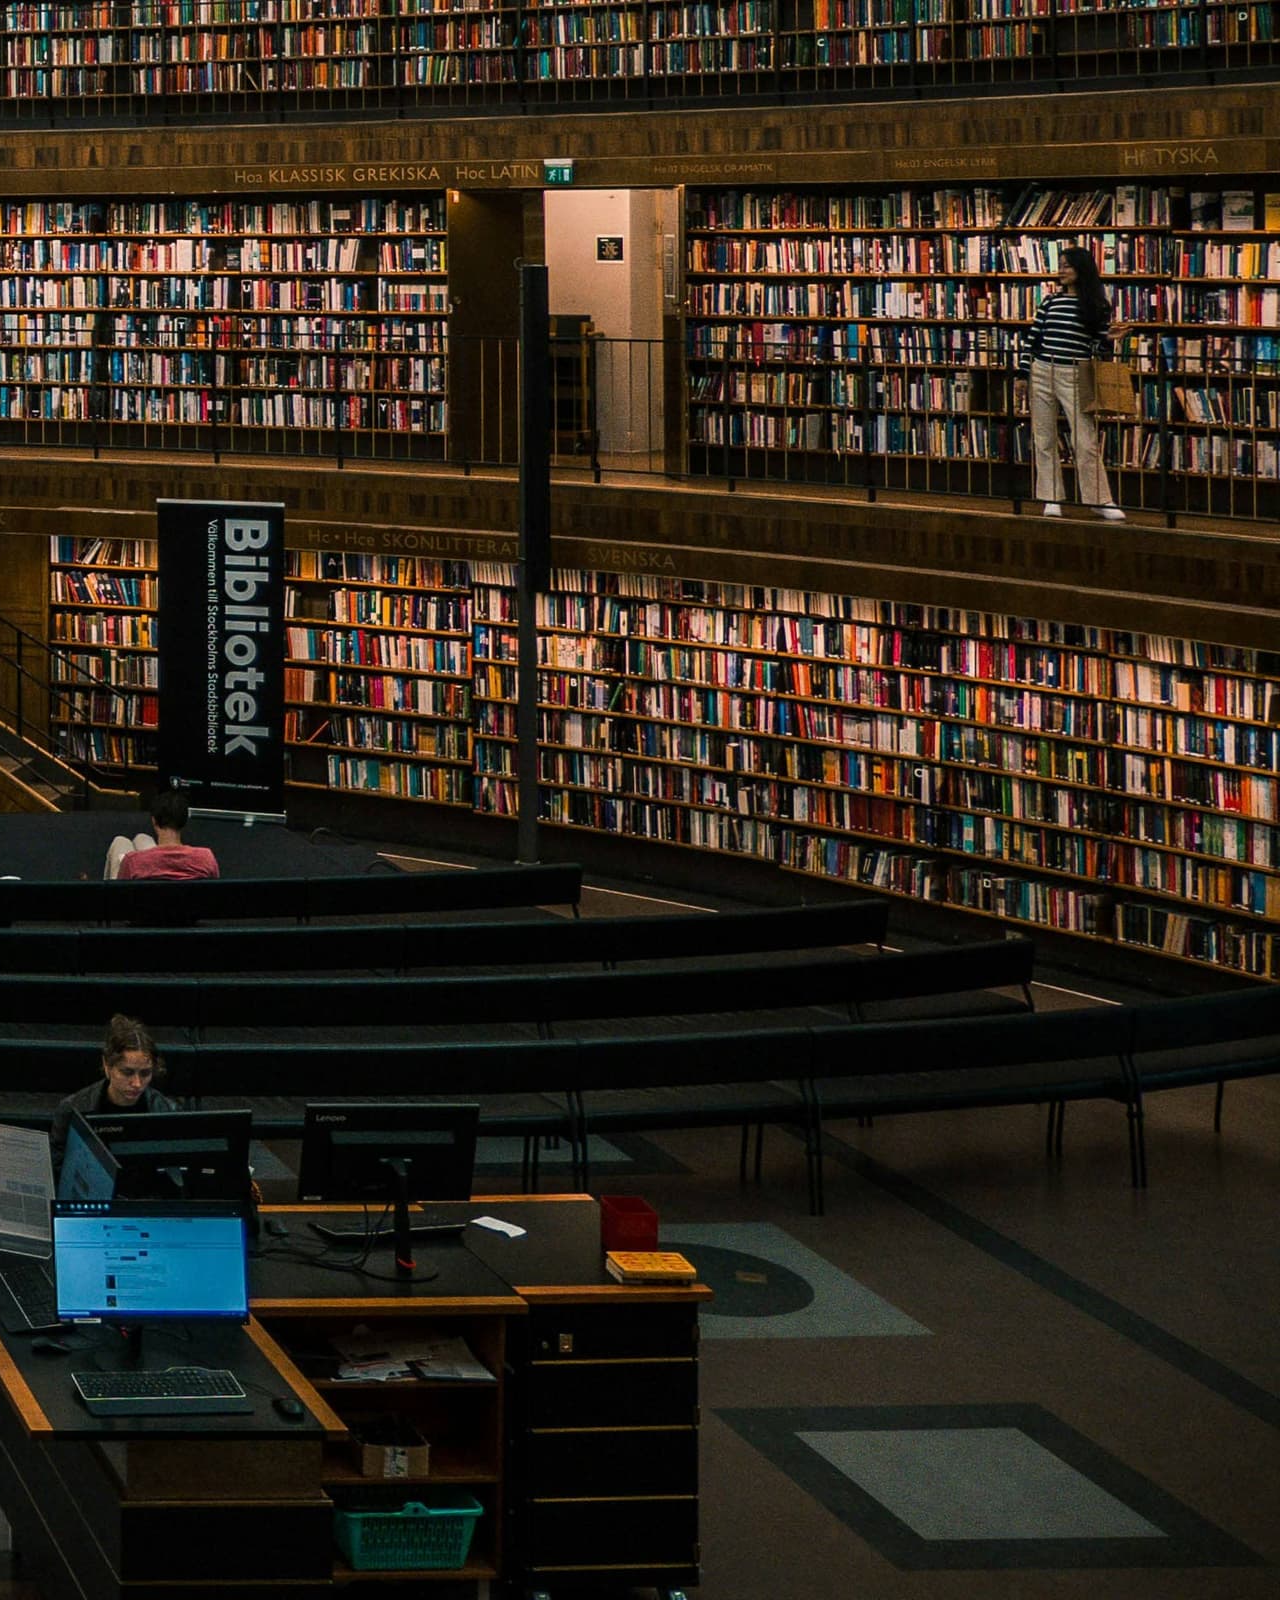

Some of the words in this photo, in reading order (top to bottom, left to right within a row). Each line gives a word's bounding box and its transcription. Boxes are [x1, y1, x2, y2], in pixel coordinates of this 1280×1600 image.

[1238, 12, 1248, 21] D
[817, 38, 824, 47] C
[1153, 147, 1218, 165] TYSKA
[234, 170, 263, 184] Hoa
[268, 168, 346, 184] KLASSISK
[353, 166, 440, 182] GREKISKA
[456, 166, 486, 180] Hoc
[490, 164, 539, 179] LATIN
[680, 163, 722, 174] ENGELSK
[724, 162, 774, 173] DRAMATIK
[307, 528, 329, 544] Hc
[344, 530, 375, 546] Hce
[383, 532, 520, 555] SKÖNLITTERAT
[207, 518, 219, 586] Välkommen
[587, 547, 677, 570] SVENSKA
[207, 588, 219, 603] till
[207, 605, 219, 670] Stockholms
[224, 518, 270, 756] Bibliotek
[570, 678, 577, 687] B
[207, 672, 219, 753] Stadsbibliotek
[983, 878, 991, 888] D
[315, 1113, 347, 1122] Lenovo
